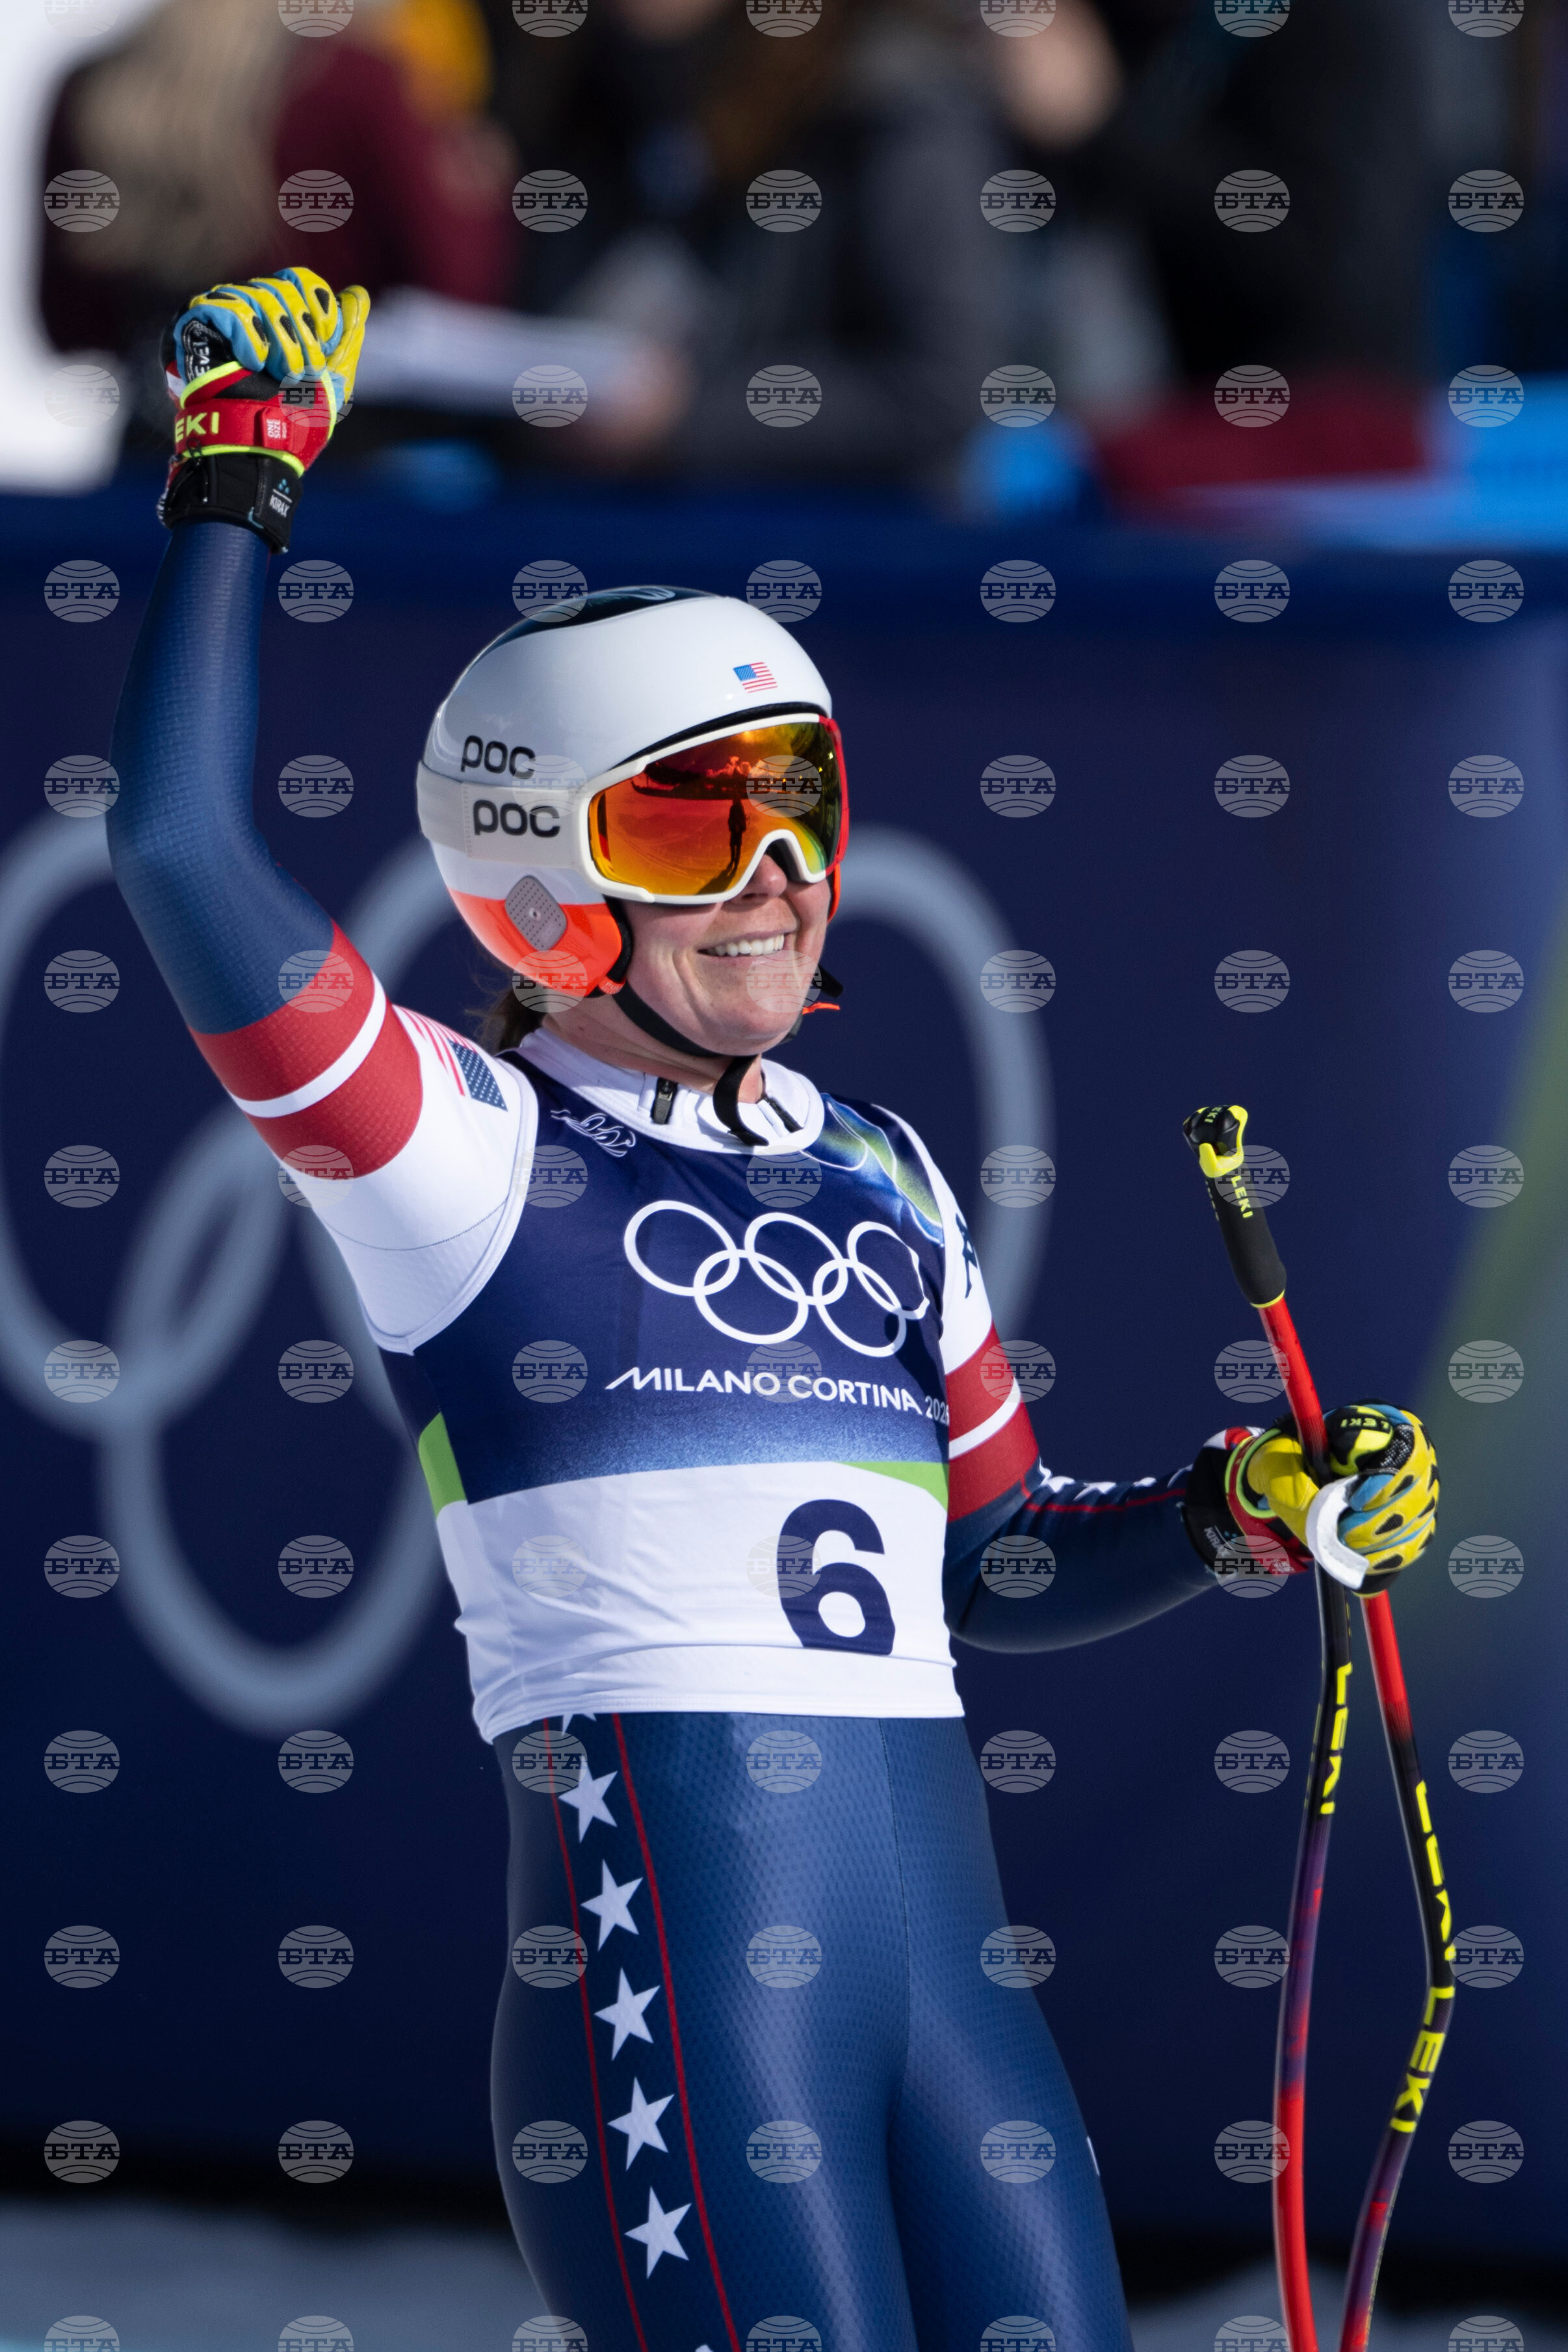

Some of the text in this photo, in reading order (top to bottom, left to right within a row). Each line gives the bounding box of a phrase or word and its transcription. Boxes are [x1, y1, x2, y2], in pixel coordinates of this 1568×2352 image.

[175, 412, 220, 443] EKI
[1204, 1107, 1222, 1123] EKI
[1231, 1175, 1253, 1218] LEKI
[605, 1367, 781, 1395] MILANO
[788, 1375, 923, 1416] CORTINA
[1340, 1418, 1390, 1429] LEKI
[776, 1499, 896, 1656] 6
[1390, 1986, 1456, 2133] LEKI
